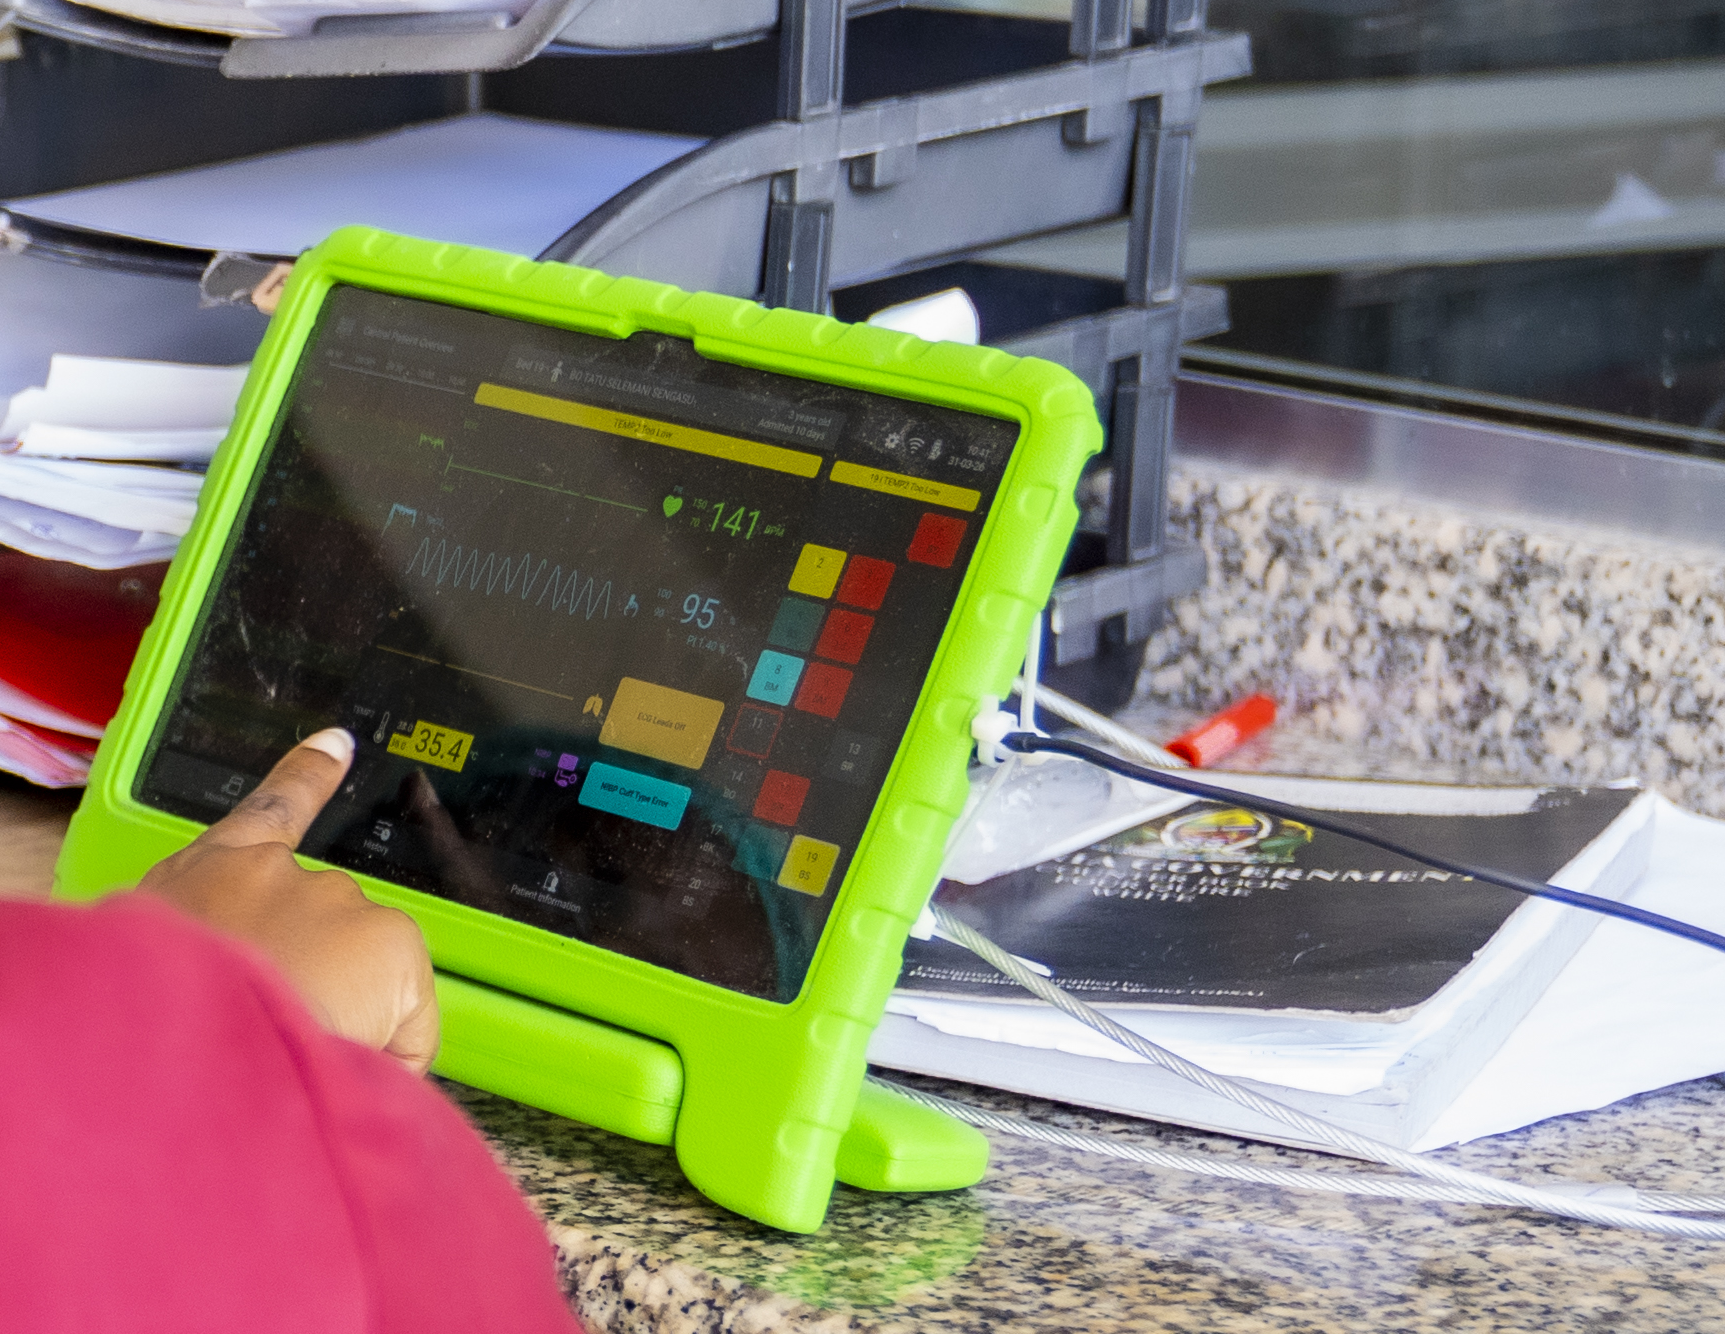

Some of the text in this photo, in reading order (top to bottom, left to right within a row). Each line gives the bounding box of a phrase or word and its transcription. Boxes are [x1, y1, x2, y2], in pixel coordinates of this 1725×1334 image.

[710, 502, 761, 540] 141
[816, 558, 824, 568] 2
[680, 593, 720, 630] 95
[774, 664, 782, 674] 8
[414, 728, 464, 764] 35.4
[362, 840, 388, 855] History
[806, 851, 818, 863] 19
[1131, 858, 1473, 884] GOVERNMEN
[510, 884, 581, 912] Patient Information
